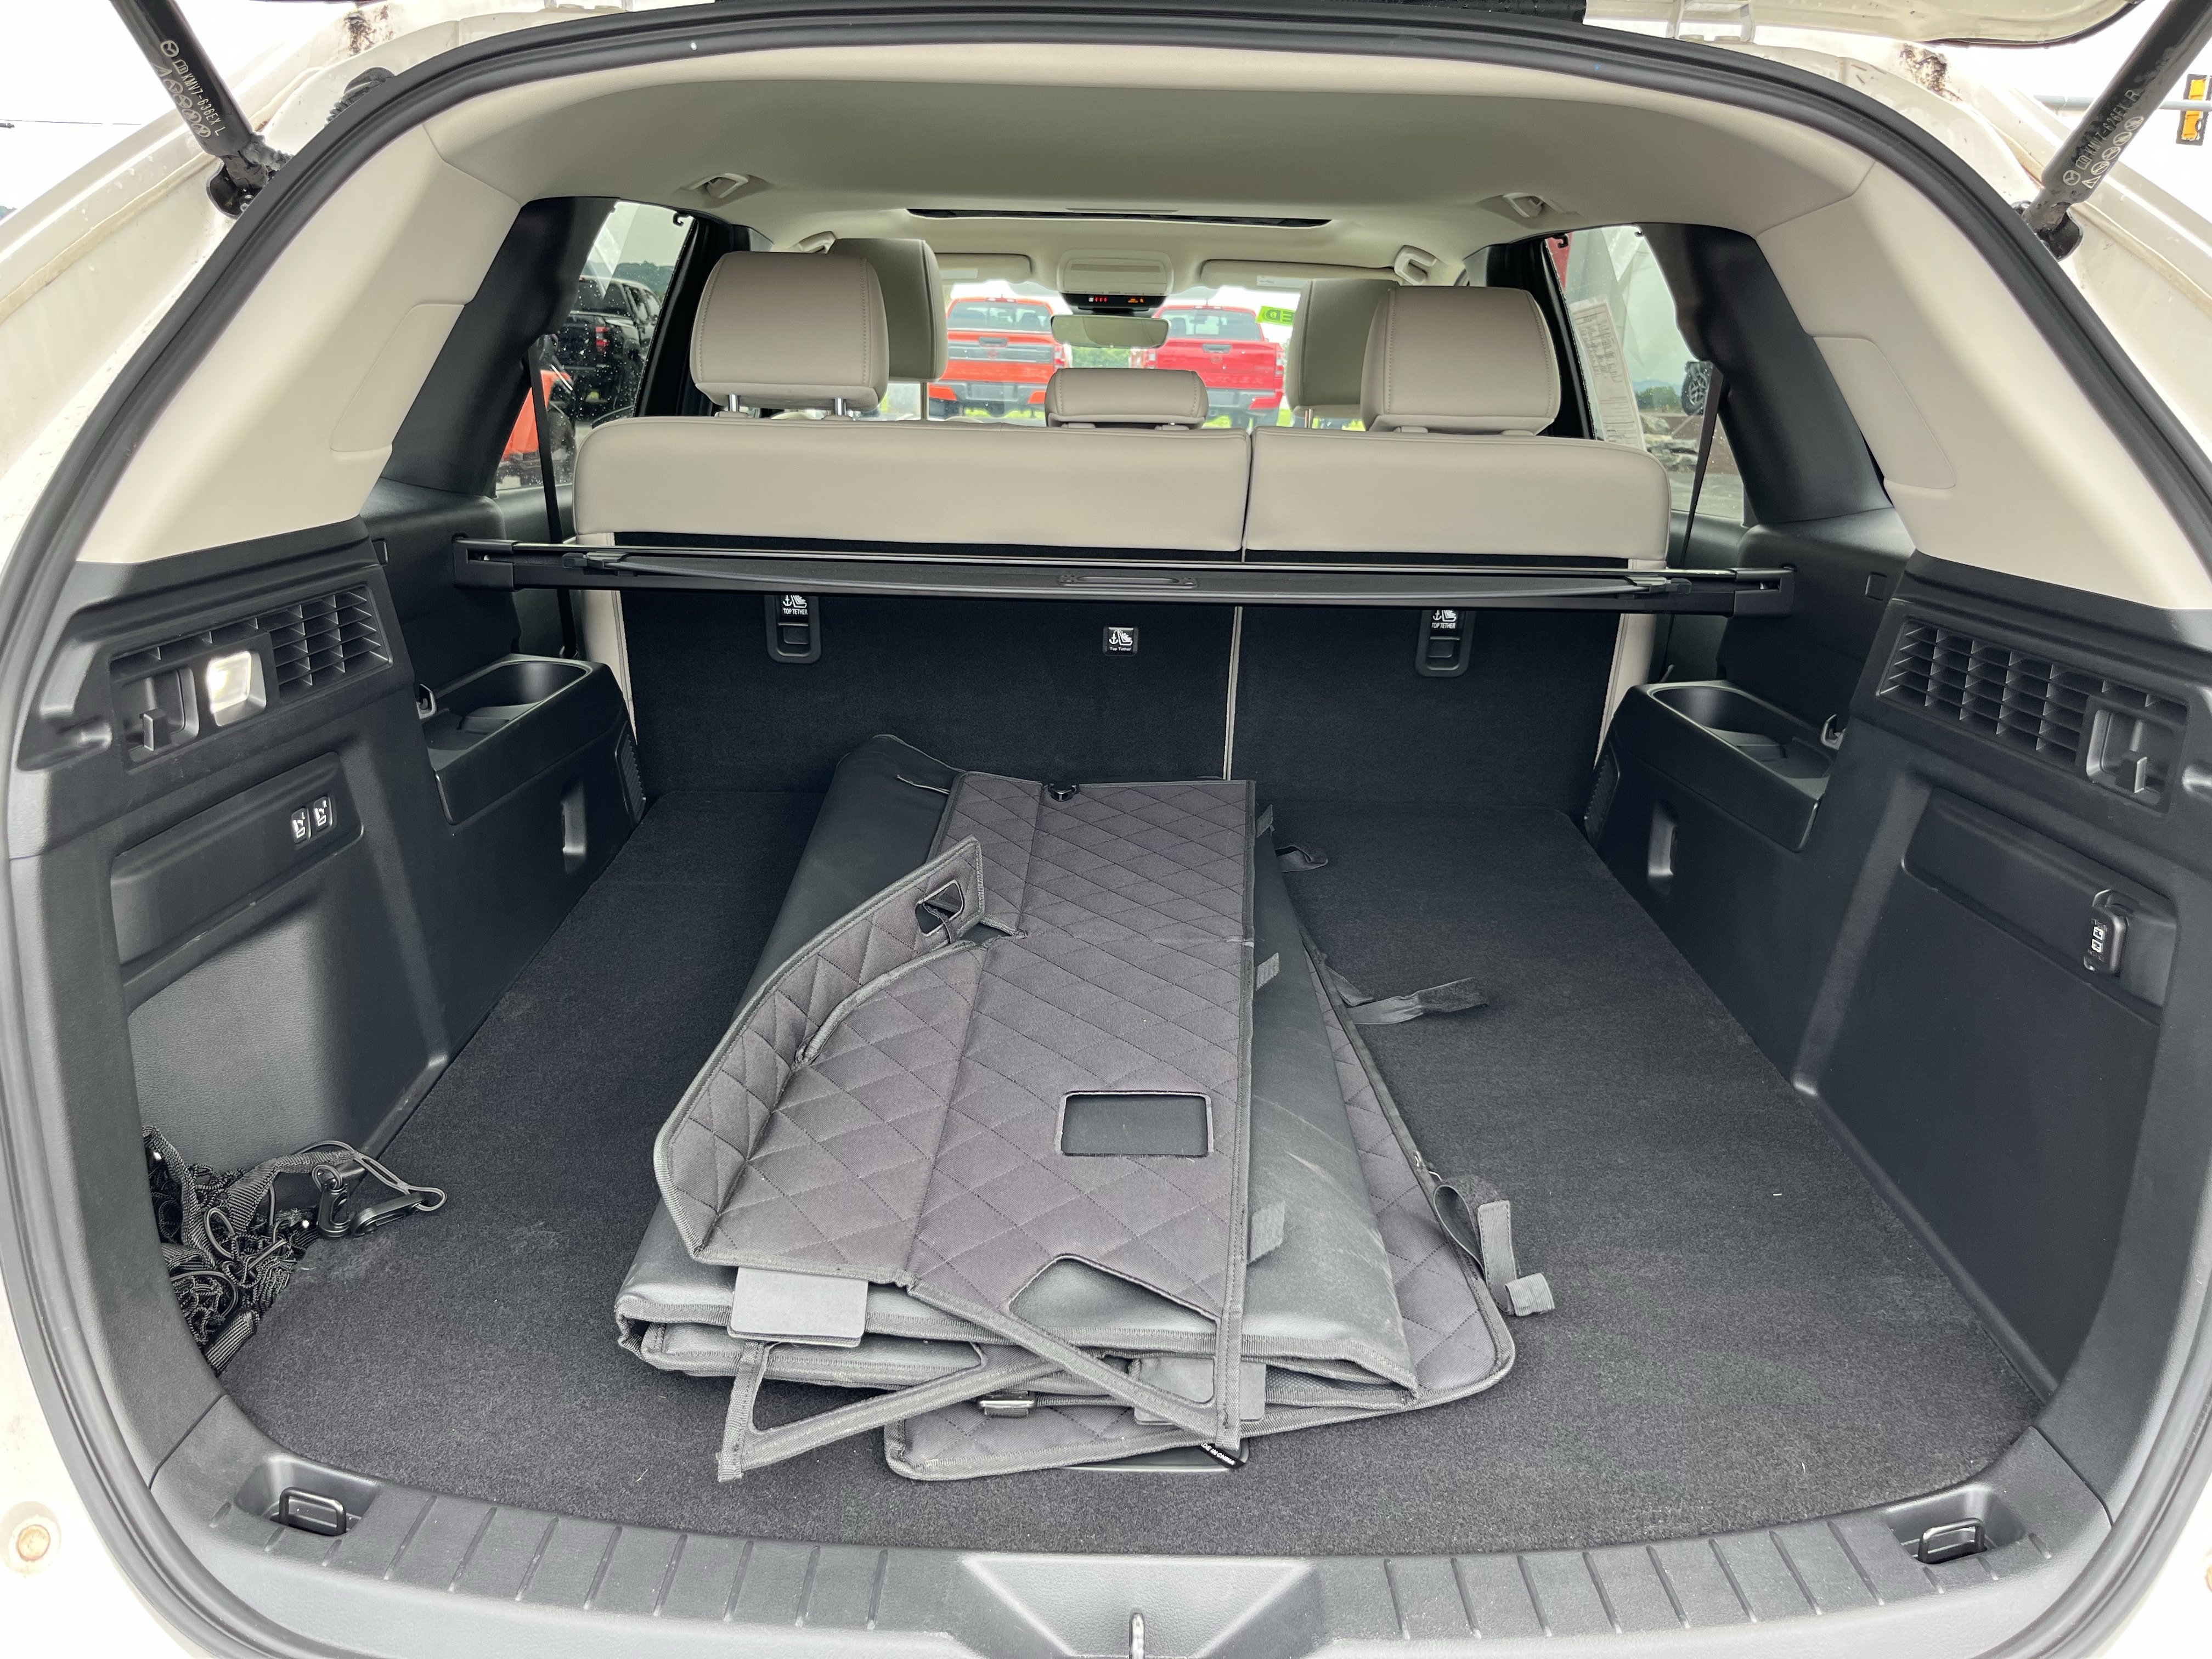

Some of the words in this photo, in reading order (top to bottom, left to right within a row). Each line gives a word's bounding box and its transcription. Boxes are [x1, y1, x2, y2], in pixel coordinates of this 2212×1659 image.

[2124, 89, 2140, 102] R
[181, 73, 222, 126] KMV7-636EX
[215, 126, 226, 137] L
[1216, 1452, 1236, 1465] CHINA
